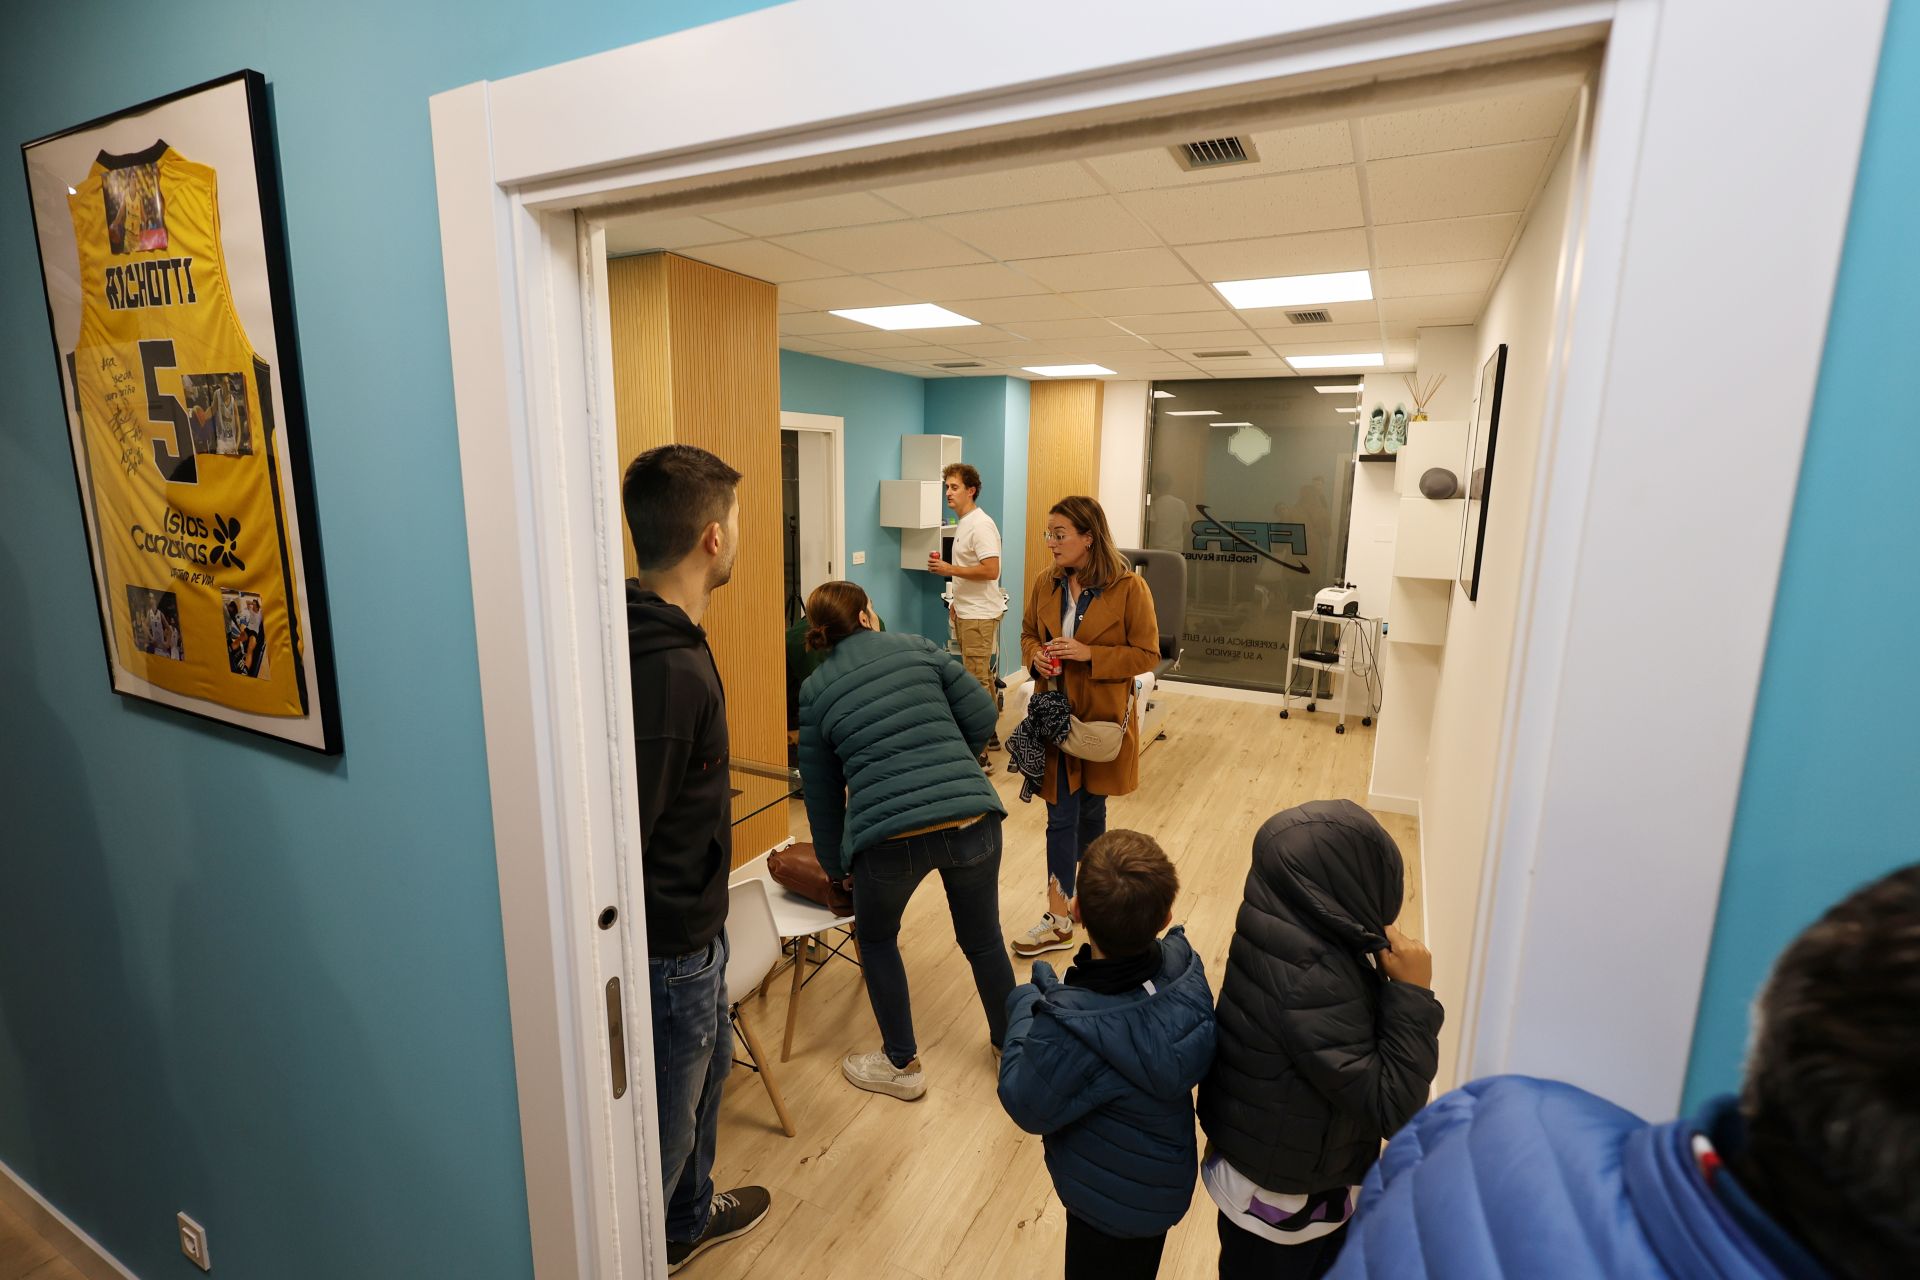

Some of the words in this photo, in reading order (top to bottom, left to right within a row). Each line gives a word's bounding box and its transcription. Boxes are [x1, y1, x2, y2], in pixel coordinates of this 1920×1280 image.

[105, 257, 196, 310] RICHOTTI
[138, 339, 198, 485] 5
[163, 506, 209, 539] Islas
[191, 572, 202, 584] DE
